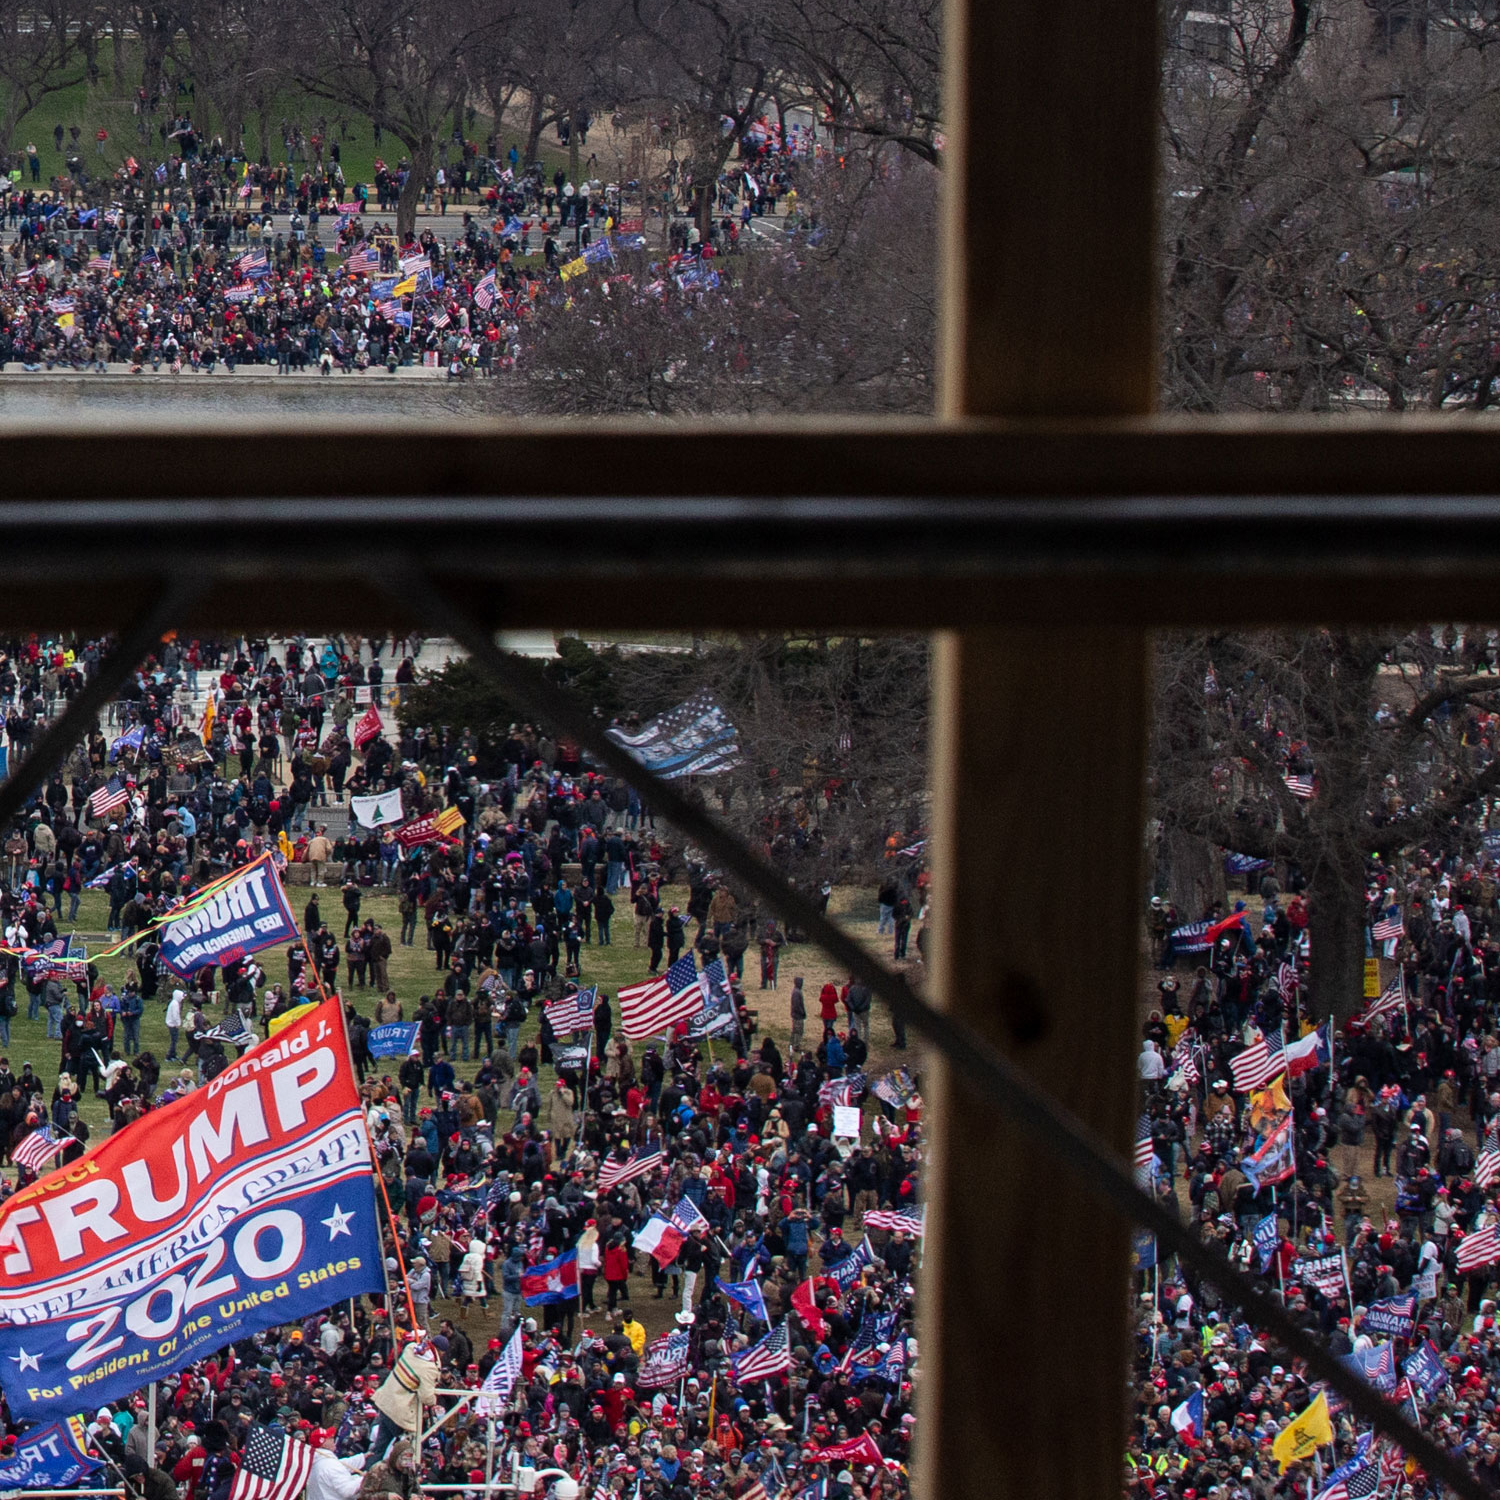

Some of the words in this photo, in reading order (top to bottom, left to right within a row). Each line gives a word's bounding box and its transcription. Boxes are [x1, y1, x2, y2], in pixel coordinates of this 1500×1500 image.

[207, 1029, 310, 1100] Donald
[316, 1018, 333, 1044] J.
[26, 1384, 65, 1402] For
[67, 1349, 151, 1392] President
[157, 1336, 179, 1358] Of
[180, 1314, 214, 1340] The
[218, 1282, 292, 1320] United
[297, 1256, 362, 1290] States
[65, 1208, 306, 1372] 2020
